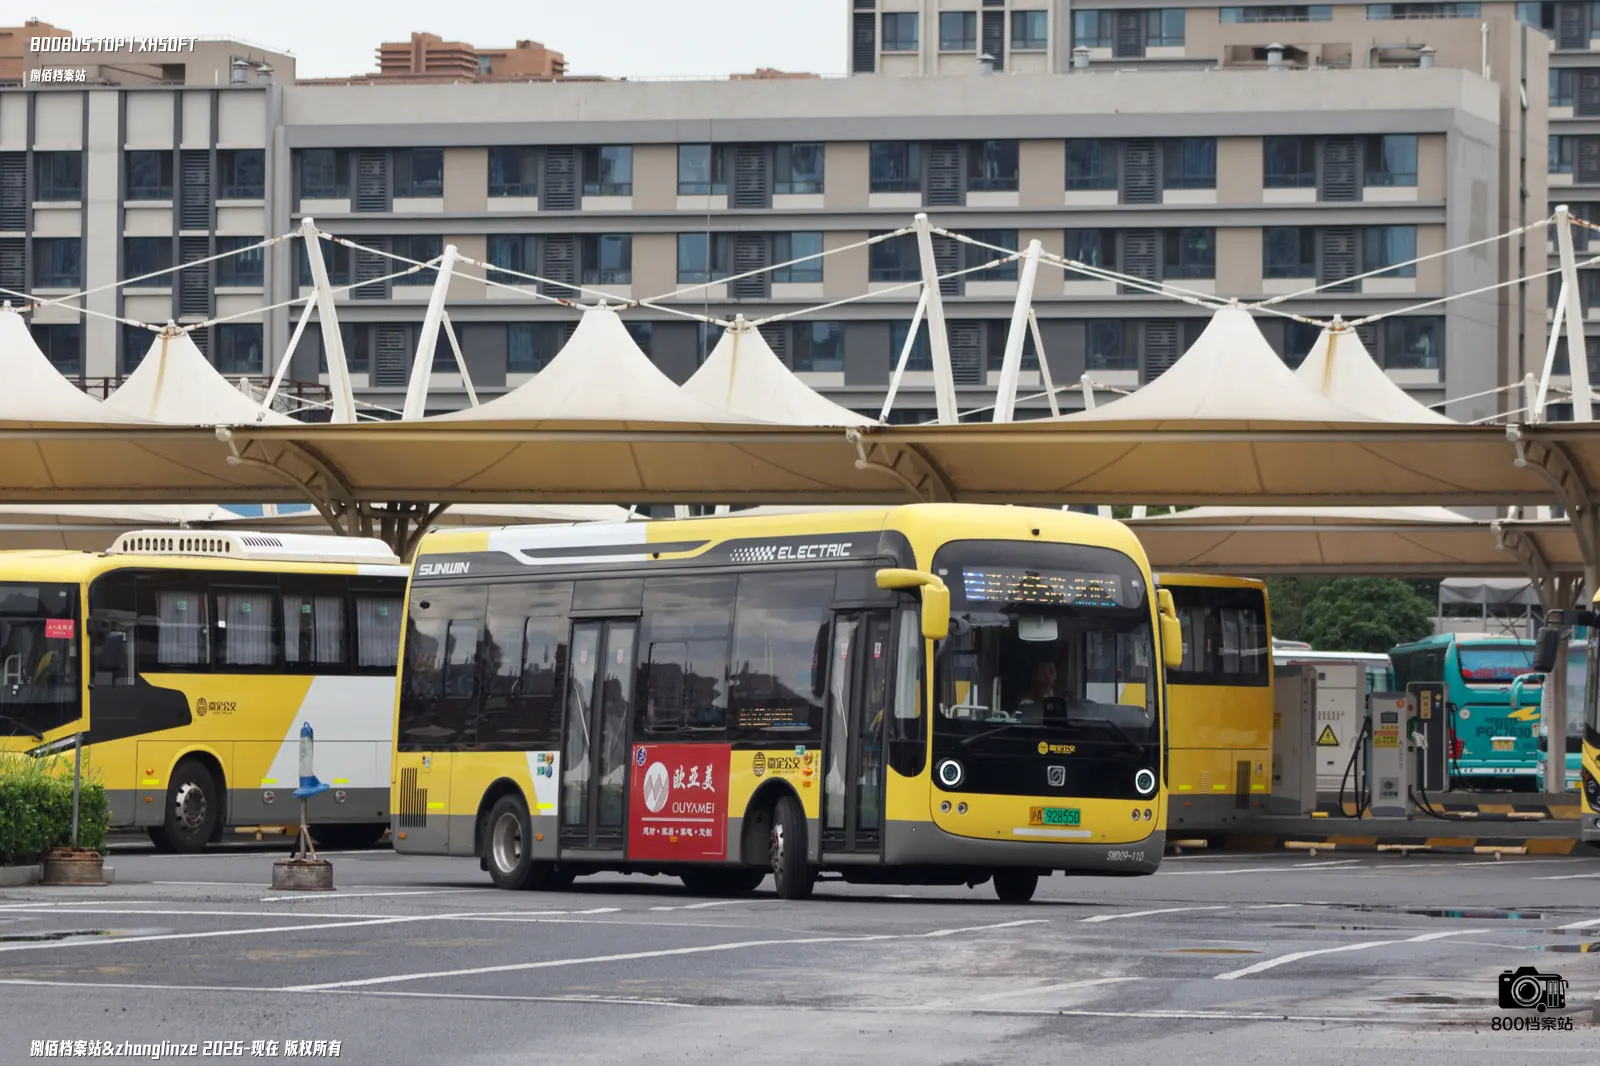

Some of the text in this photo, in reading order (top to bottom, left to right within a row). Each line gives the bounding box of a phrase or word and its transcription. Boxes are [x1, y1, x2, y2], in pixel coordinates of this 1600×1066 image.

[777, 543, 852, 560] ELECTRIC
[418, 561, 470, 576] SUNWIN
[767, 757, 801, 770] 嘉定公交
[673, 764, 716, 793] 欧亚美
[671, 801, 715, 814] OUYAMEI
